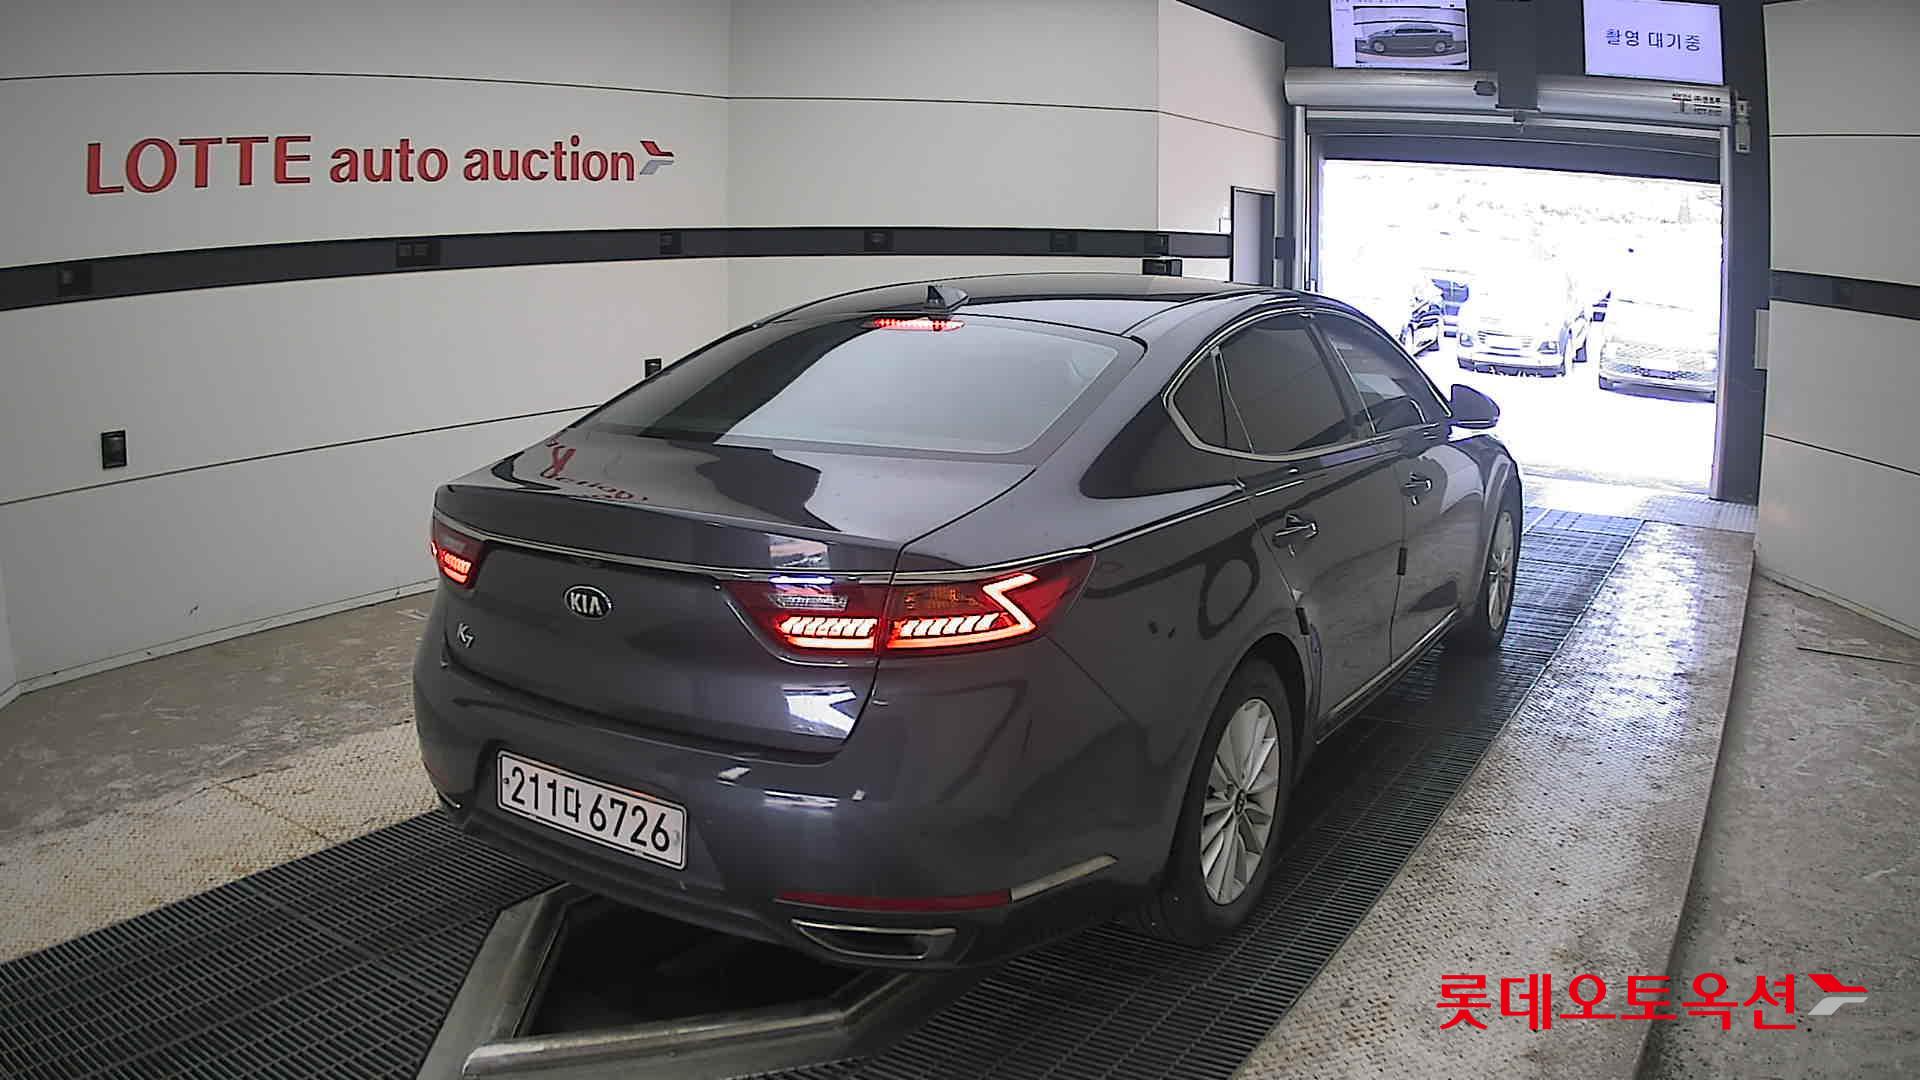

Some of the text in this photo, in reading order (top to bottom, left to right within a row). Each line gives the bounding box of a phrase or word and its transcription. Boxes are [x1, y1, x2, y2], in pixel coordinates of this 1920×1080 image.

[87, 135, 636, 194] LOTTE auto auction
[570, 591, 603, 616] KIA
[457, 624, 474, 648] K7
